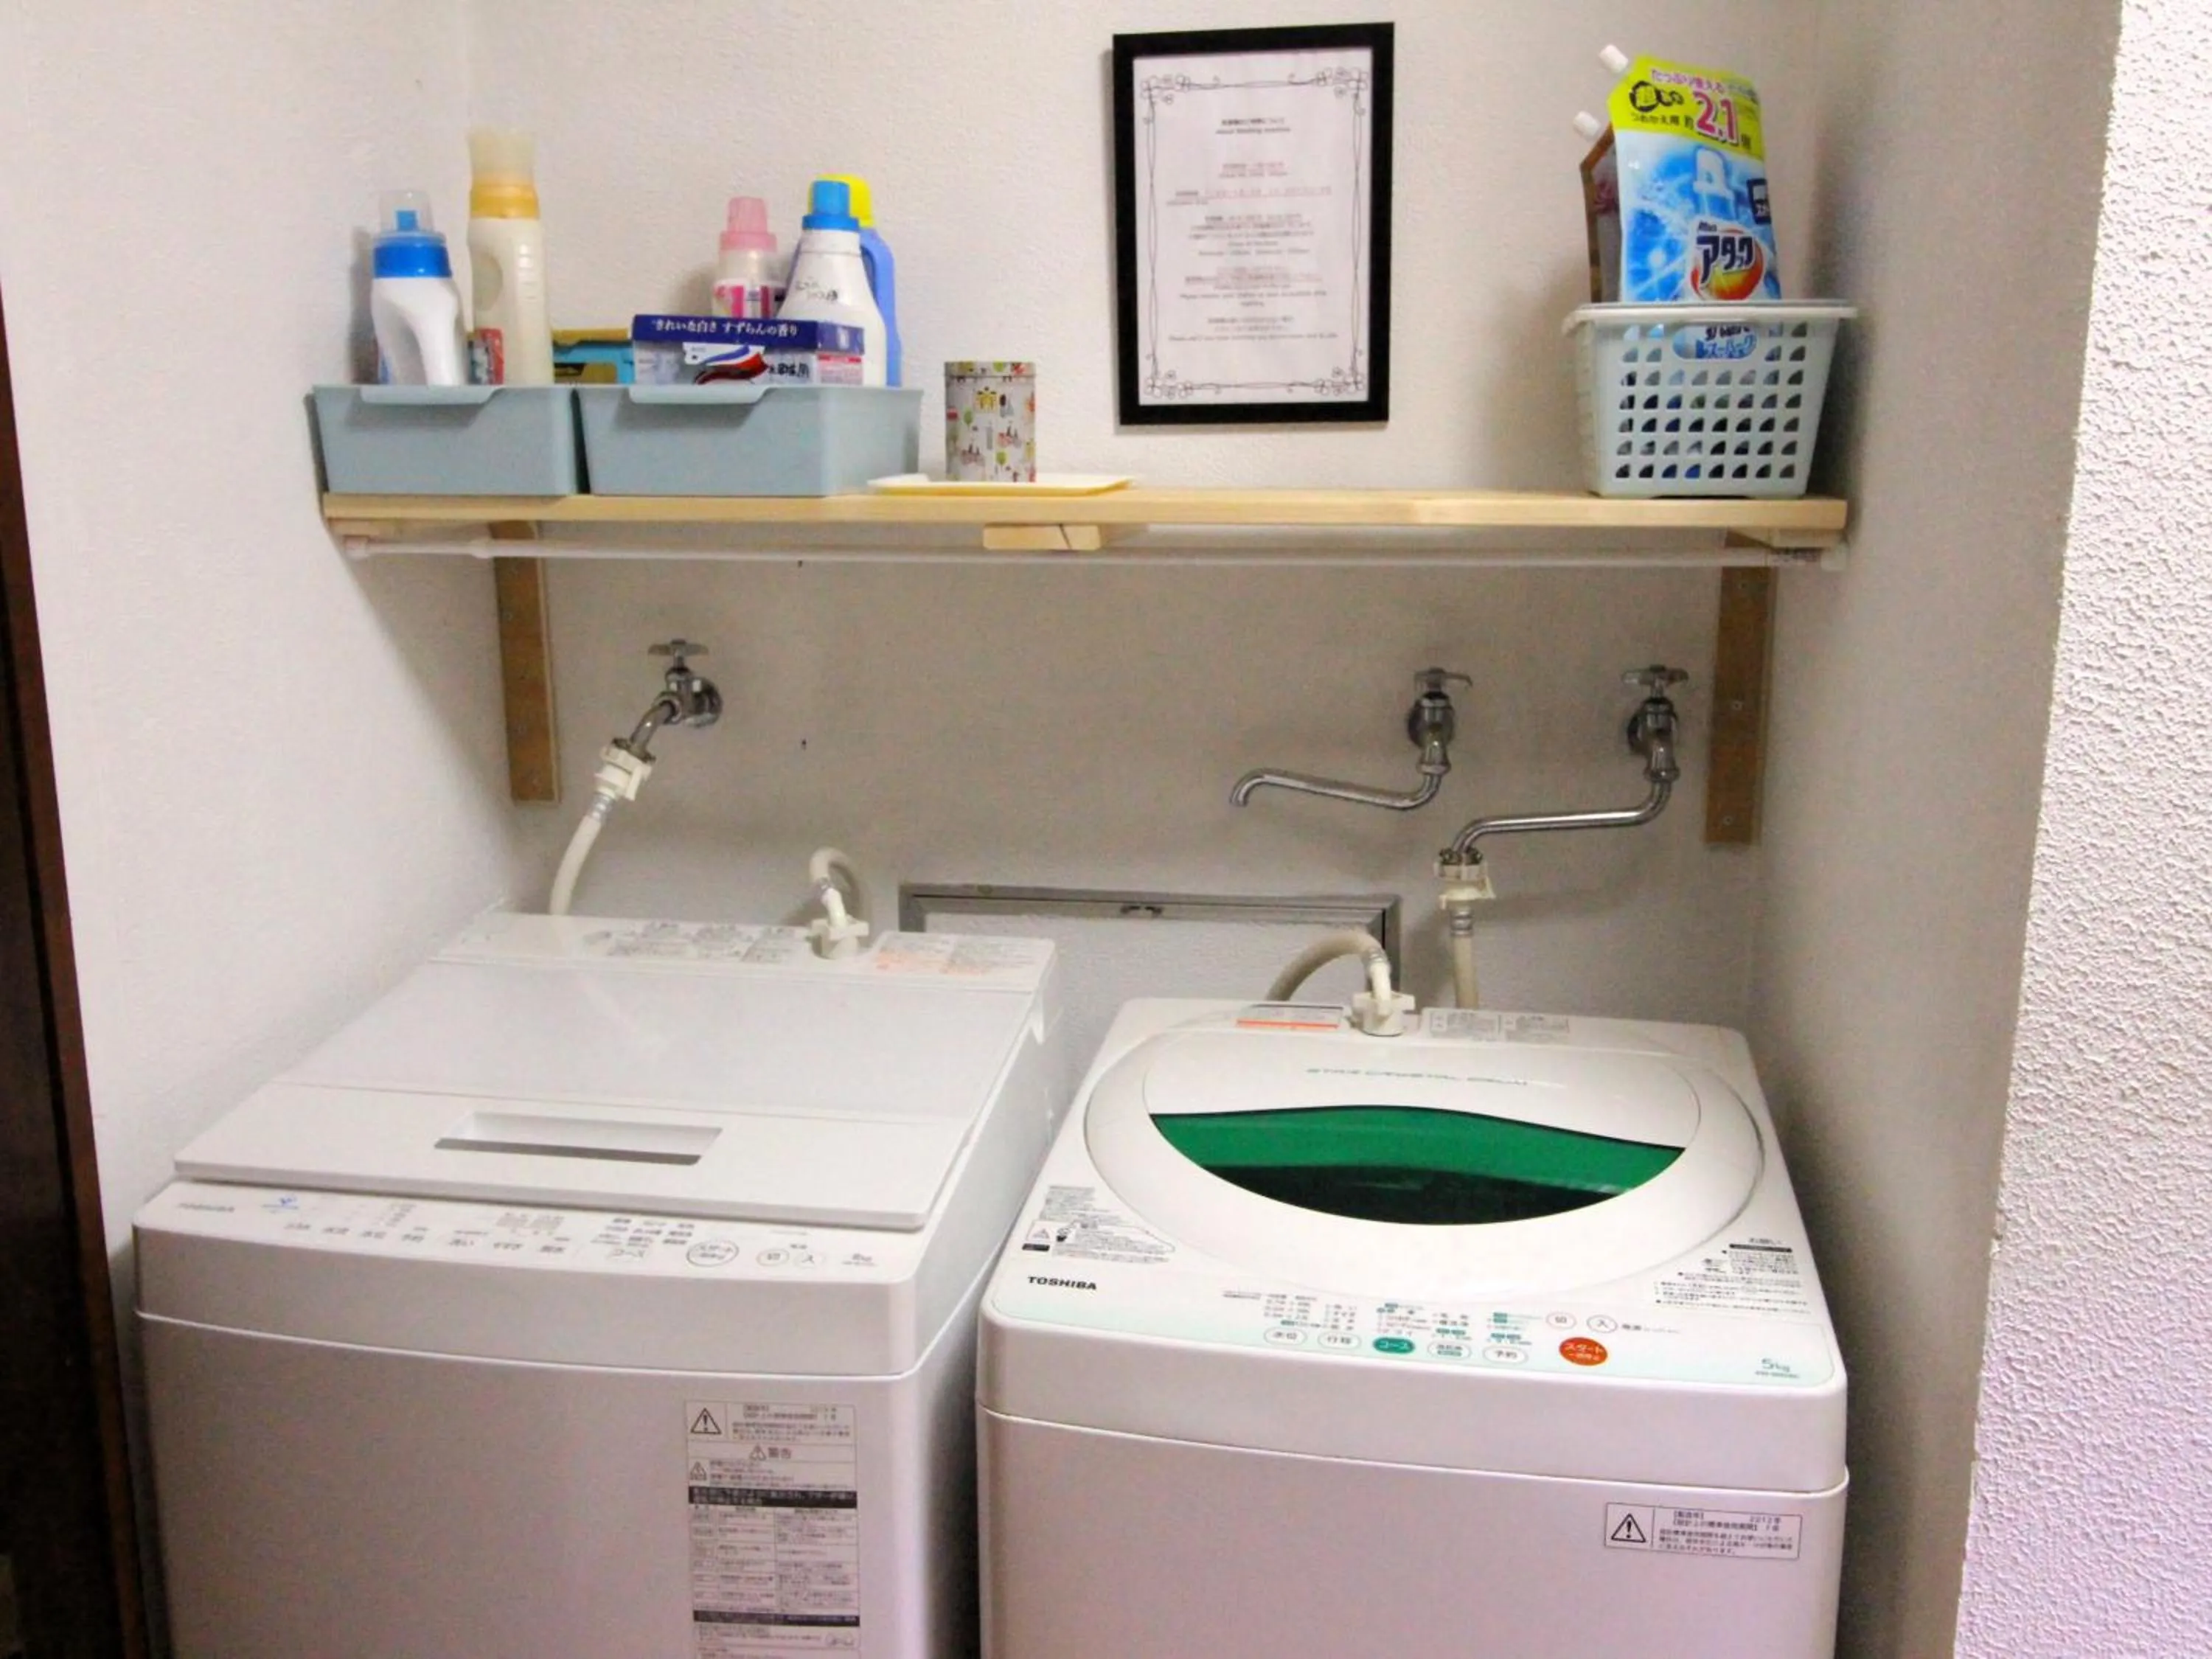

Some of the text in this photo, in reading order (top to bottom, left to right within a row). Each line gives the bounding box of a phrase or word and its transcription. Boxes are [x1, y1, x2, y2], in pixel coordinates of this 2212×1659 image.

[1696, 235, 1754, 284] アタック
[1028, 1276, 1097, 1291] TOSHIBA
